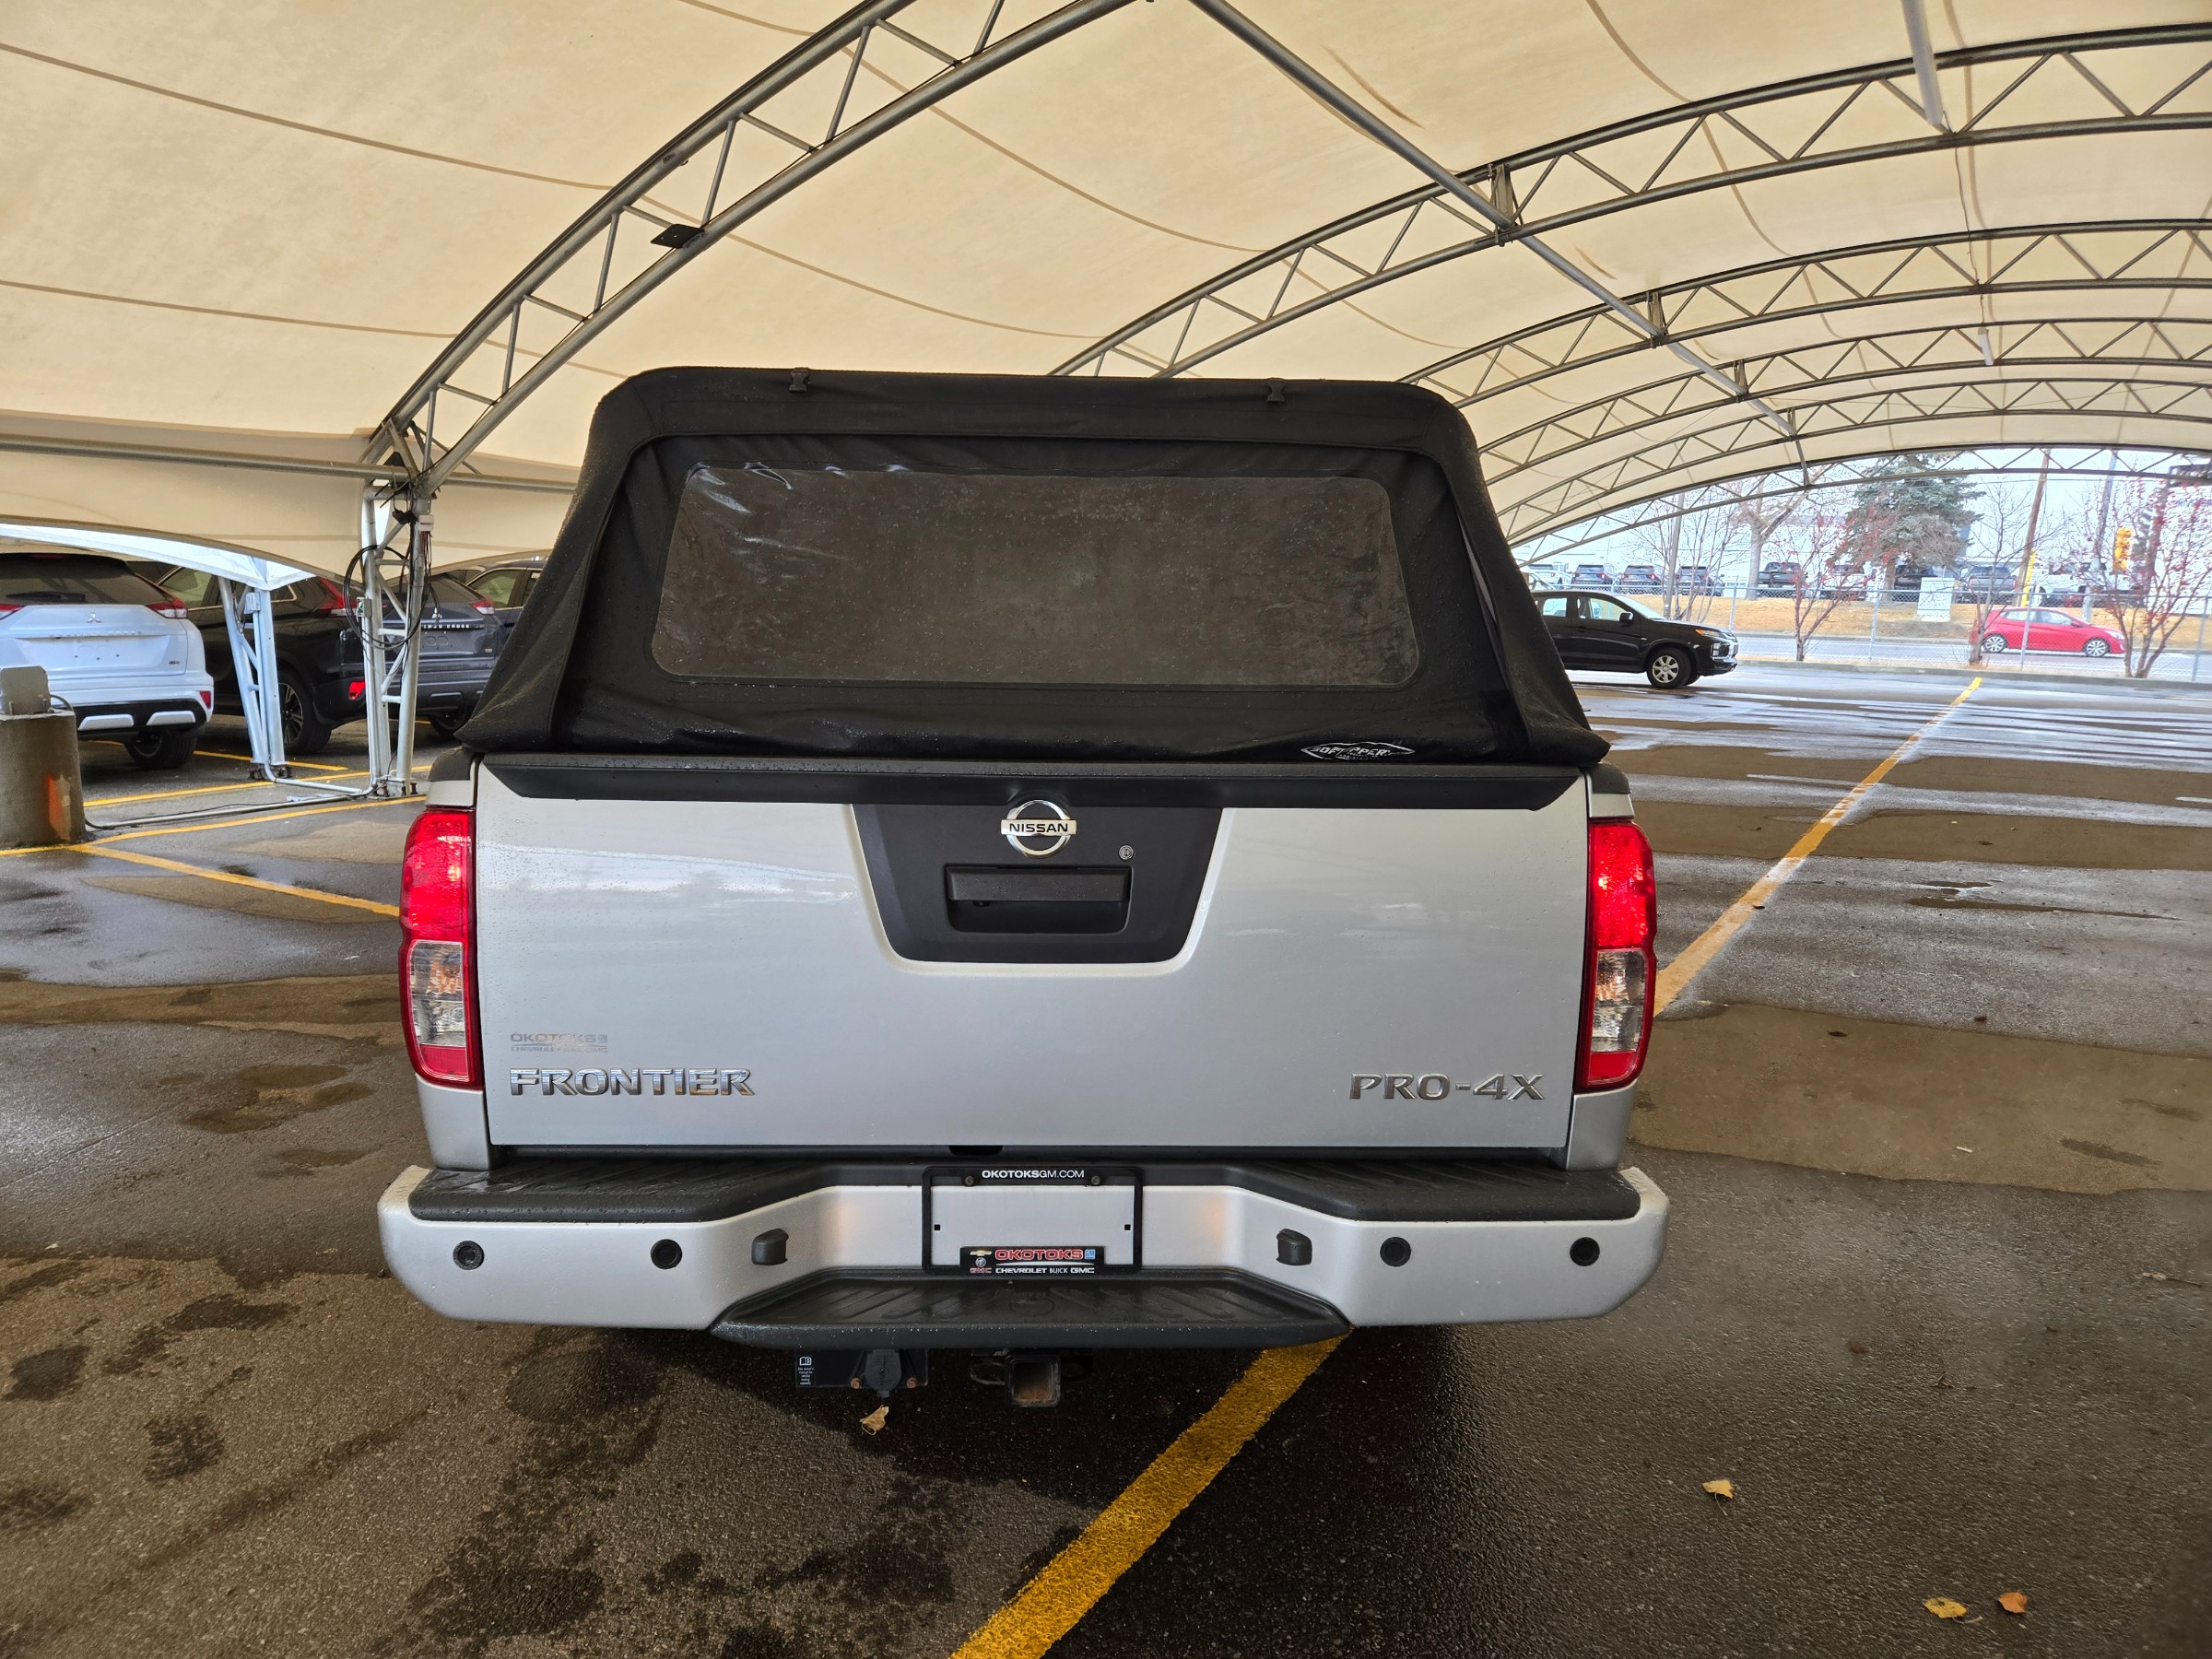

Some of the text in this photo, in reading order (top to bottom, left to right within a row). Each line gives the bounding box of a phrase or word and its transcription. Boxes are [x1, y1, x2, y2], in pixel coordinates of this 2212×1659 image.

[1009, 823, 1068, 833] NISSAN
[510, 1067, 755, 1096] FRONTIER
[1349, 1073, 1545, 1100] PRO-4X
[982, 1170, 1085, 1179] OKOTOKSGM.COM
[995, 1249, 1096, 1260] OKOTOKS GM
